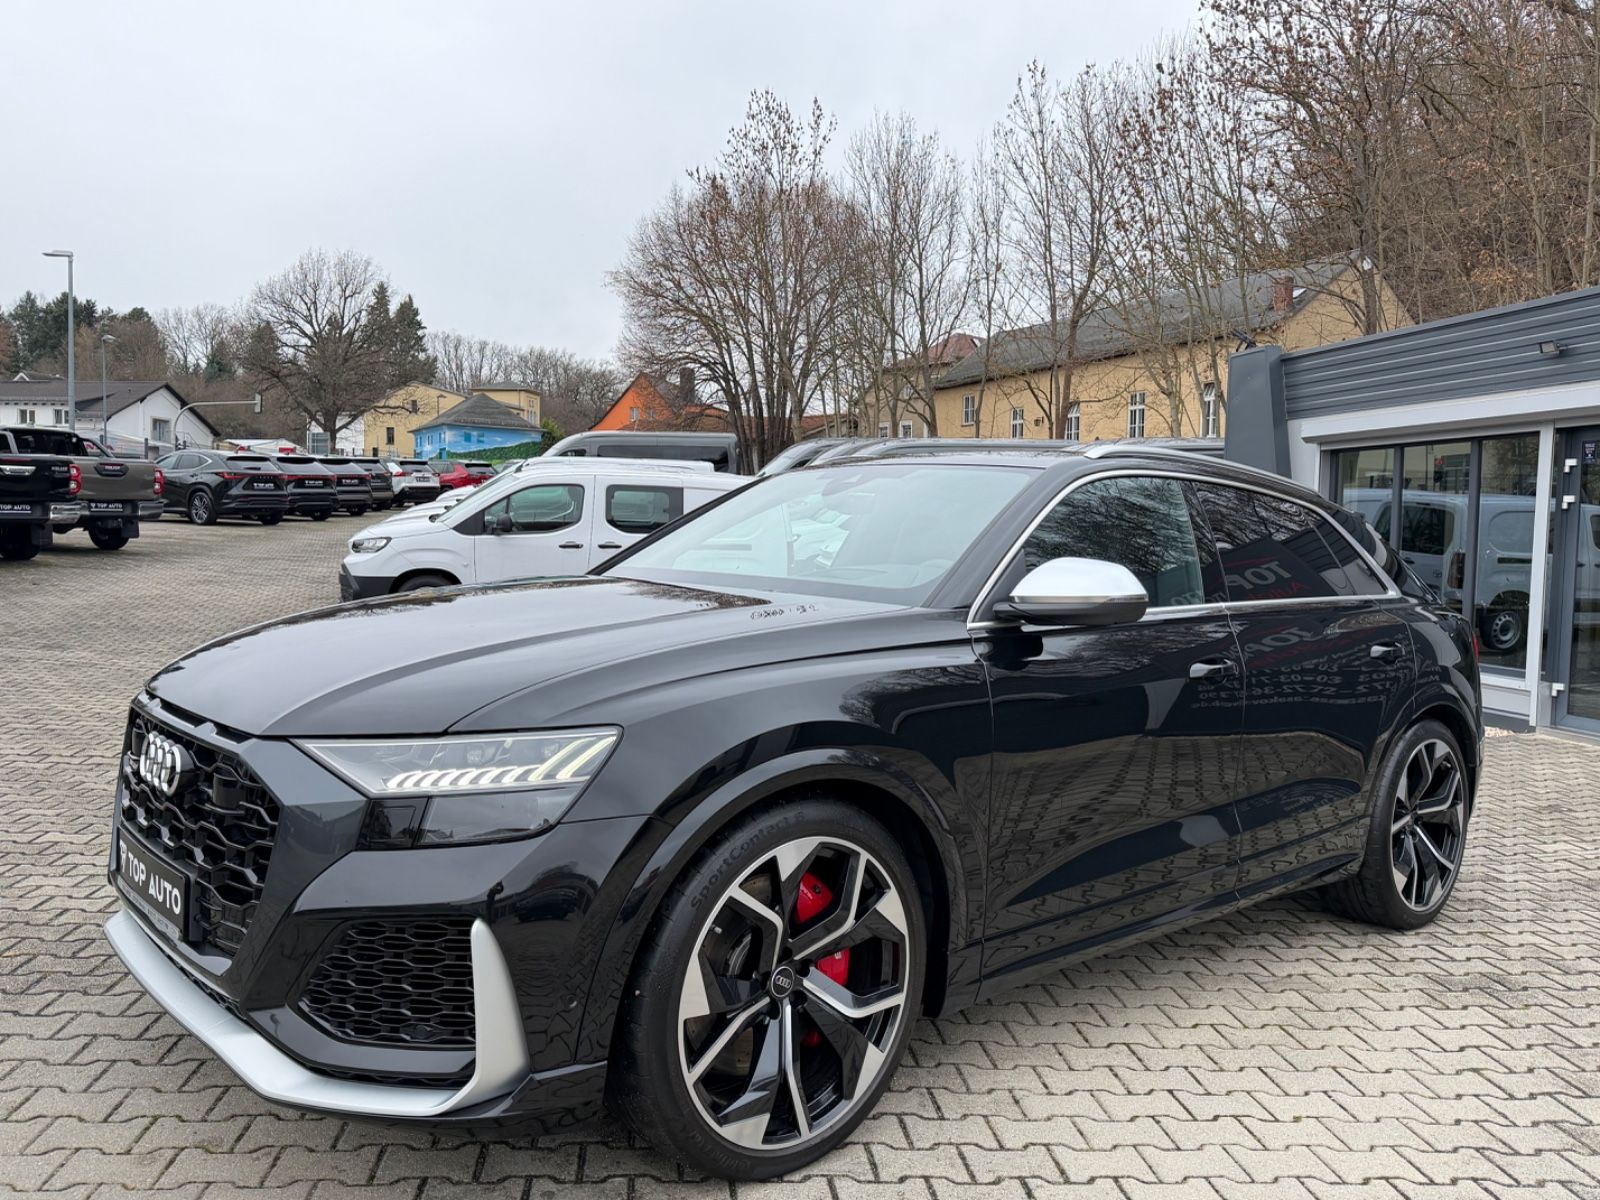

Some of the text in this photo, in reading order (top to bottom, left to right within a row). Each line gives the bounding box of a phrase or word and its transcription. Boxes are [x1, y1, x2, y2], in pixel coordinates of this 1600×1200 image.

[128, 851, 146, 887] TOP
[148, 872, 181, 915] AUTO
[690, 817, 790, 908] SportContact
